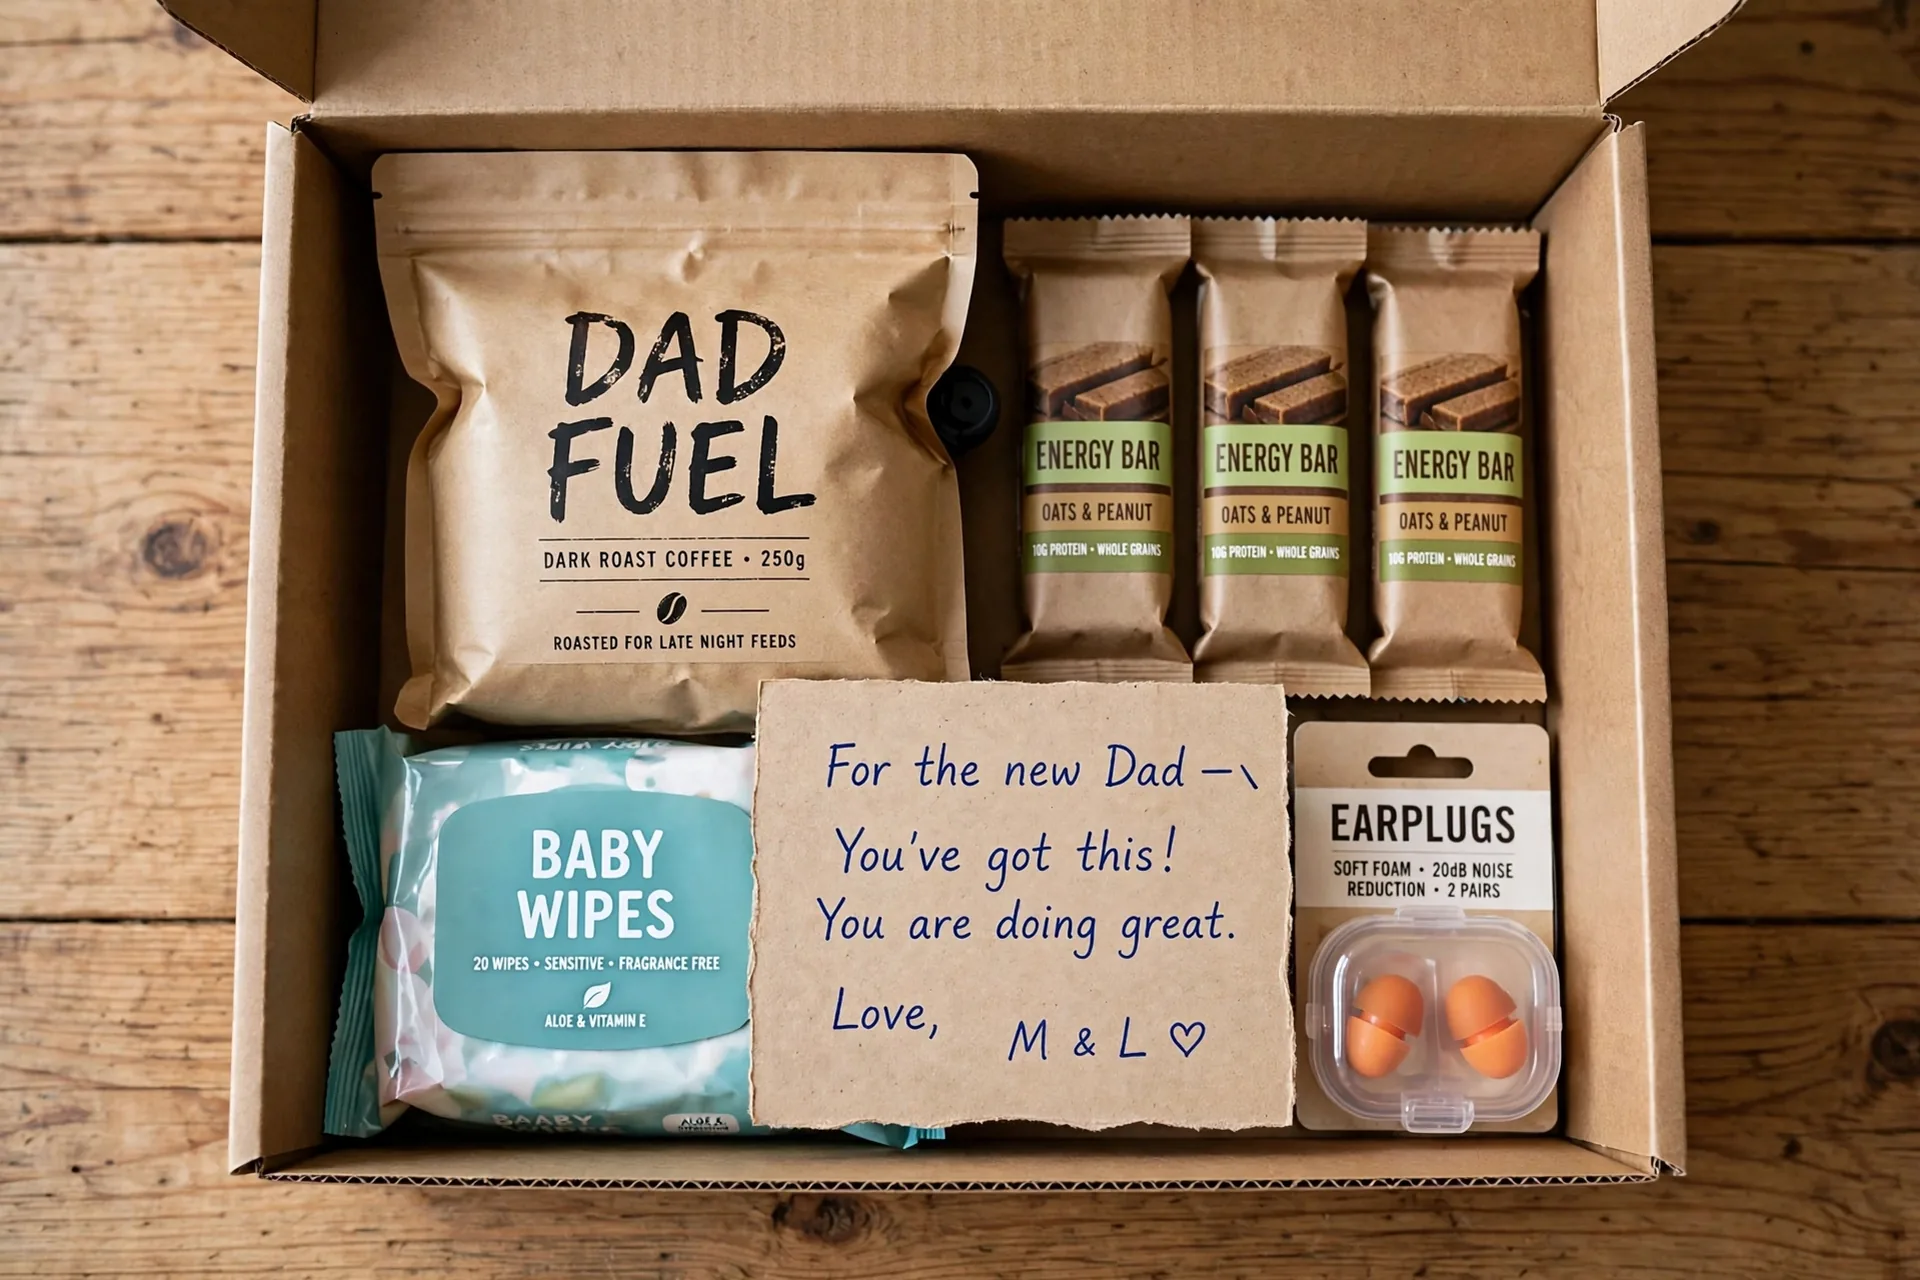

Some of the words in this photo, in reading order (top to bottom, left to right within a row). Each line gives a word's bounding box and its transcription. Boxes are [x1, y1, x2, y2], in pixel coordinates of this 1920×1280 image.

[565, 310, 785, 406] DAD
[547, 415, 817, 523] FUEL
[1037, 440, 1113, 470] ENERGY
[1122, 440, 1160, 471] BAR
[1216, 443, 1293, 472] ENERGY
[1301, 444, 1338, 474] BAR
[1394, 450, 1470, 479] ENERGY
[1479, 451, 1515, 482] BAR
[1042, 503, 1076, 520] OATS
[1082, 503, 1091, 520] &
[1098, 503, 1152, 521] PEANUT
[1222, 506, 1255, 523] OATS
[1262, 506, 1270, 523] &
[1278, 506, 1331, 524] PEANUT
[1399, 512, 1433, 530] OATS
[1439, 512, 1448, 530] &
[1455, 513, 1507, 532] PEANUT
[545, 552, 590, 568] DARK
[600, 551, 656, 567] ROAST
[666, 551, 732, 567] COFFEE
[762, 550, 804, 570] 250g
[1050, 543, 1087, 555] PROTEIN
[1097, 543, 1128, 555] WHOLE
[1130, 543, 1161, 555] GRAINS
[1229, 546, 1266, 557] PROTEIN
[1276, 546, 1307, 558] WHOLE
[1309, 546, 1339, 559] GRAINS
[1407, 552, 1444, 564] PROTEIN
[1454, 553, 1484, 565] WHOLE
[1487, 553, 1515, 567] GRAINS
[554, 636, 617, 650] ROASTED
[626, 636, 652, 649] FOR
[660, 635, 693, 649] LATE
[701, 635, 744, 648] NIGHT
[752, 635, 795, 648] FEEDS
[828, 743, 891, 787] For
[915, 743, 979, 786] the
[1006, 762, 1080, 786] new
[1106, 745, 1185, 787] Dad
[1332, 804, 1514, 843] EARPLUGS
[533, 830, 663, 878] BABY
[836, 827, 960, 873] You've
[986, 833, 1051, 892] got
[1334, 860, 1368, 876] SOFT
[1373, 861, 1410, 876] FOAM
[1433, 862, 1466, 877] 20dB
[1473, 863, 1512, 878] NOISE
[1348, 881, 1424, 896] REDUCTION
[1448, 883, 1455, 897] 2
[1461, 883, 1500, 898] PAIRS
[518, 890, 674, 938] WIPES
[817, 897, 884, 941] You
[910, 916, 971, 939] are
[997, 899, 1095, 959] doing
[1119, 901, 1234, 959] great.
[474, 957, 488, 970] 20
[492, 957, 529, 970] WIPES
[545, 957, 604, 970] SENSITIVE
[620, 956, 688, 970] FRAGRANCE
[692, 957, 720, 970] FREE
[545, 1015, 573, 1027] ALOE
[577, 1014, 585, 1027] &
[589, 1014, 635, 1027] VITAMIN
[640, 1014, 646, 1027] E
[833, 987, 937, 1039] Love,
[1008, 1020, 1046, 1061] M
[1074, 1028, 1095, 1056] &
[1120, 1017, 1146, 1057] L
